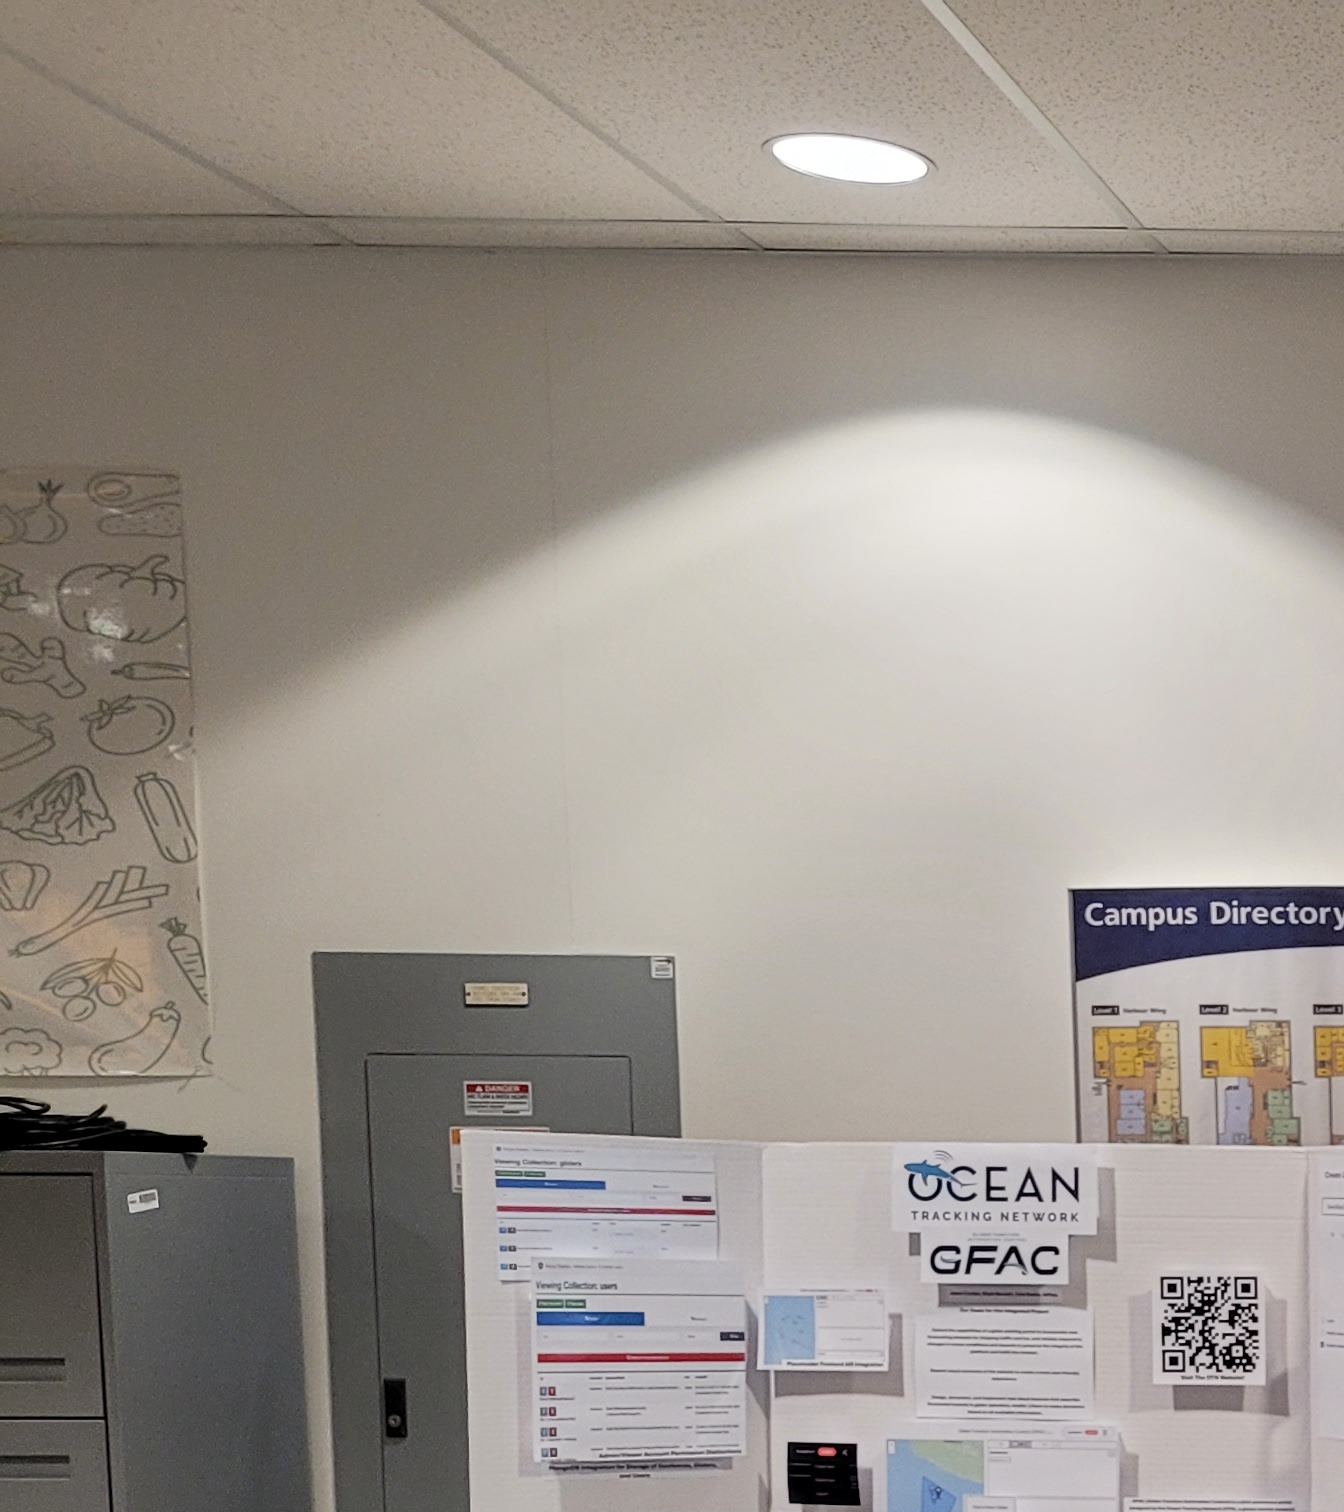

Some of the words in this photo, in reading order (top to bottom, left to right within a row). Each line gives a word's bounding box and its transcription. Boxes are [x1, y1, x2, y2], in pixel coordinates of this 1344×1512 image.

[1084, 902, 1198, 931] Campus
[907, 1165, 1080, 1203] OCEAN
[911, 1210, 992, 1222] TRACKING
[1000, 1211, 1080, 1223] NETWORK
[930, 1245, 1060, 1276] GFAC
